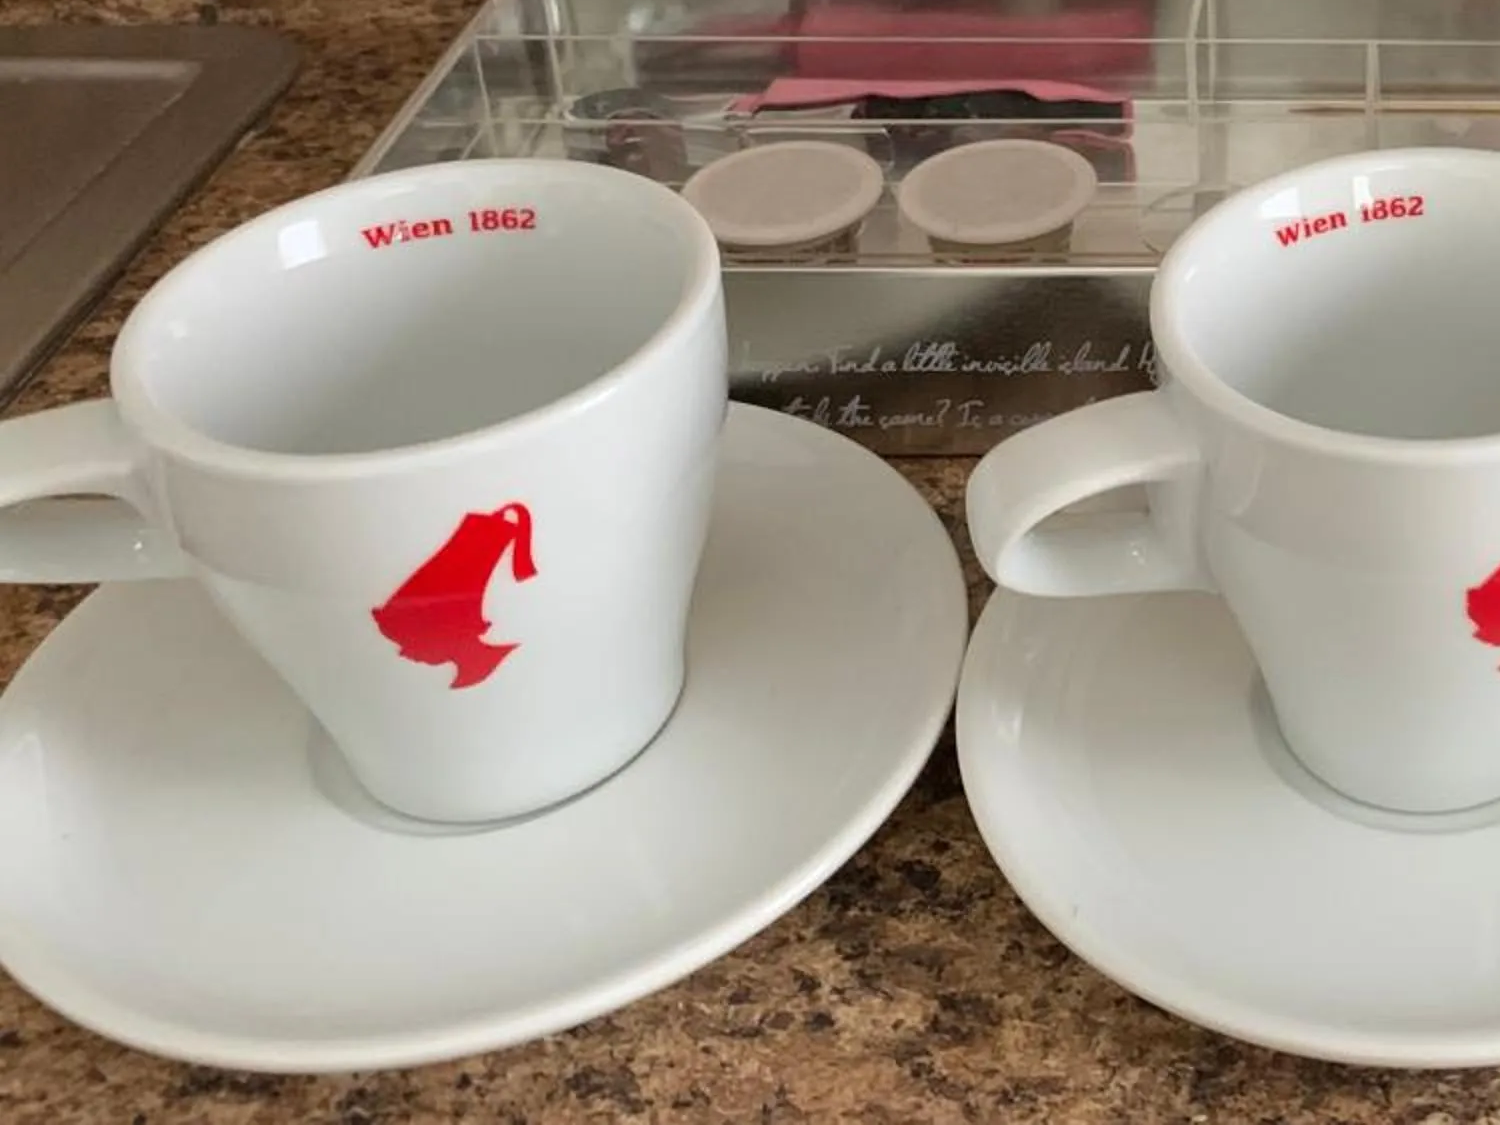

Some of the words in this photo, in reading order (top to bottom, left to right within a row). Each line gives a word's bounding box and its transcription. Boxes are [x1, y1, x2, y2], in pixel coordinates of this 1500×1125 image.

[361, 217, 453, 248] Wien
[468, 208, 537, 232] 1862
[1275, 211, 1347, 248] Wien
[1361, 196, 1424, 222] 1862
